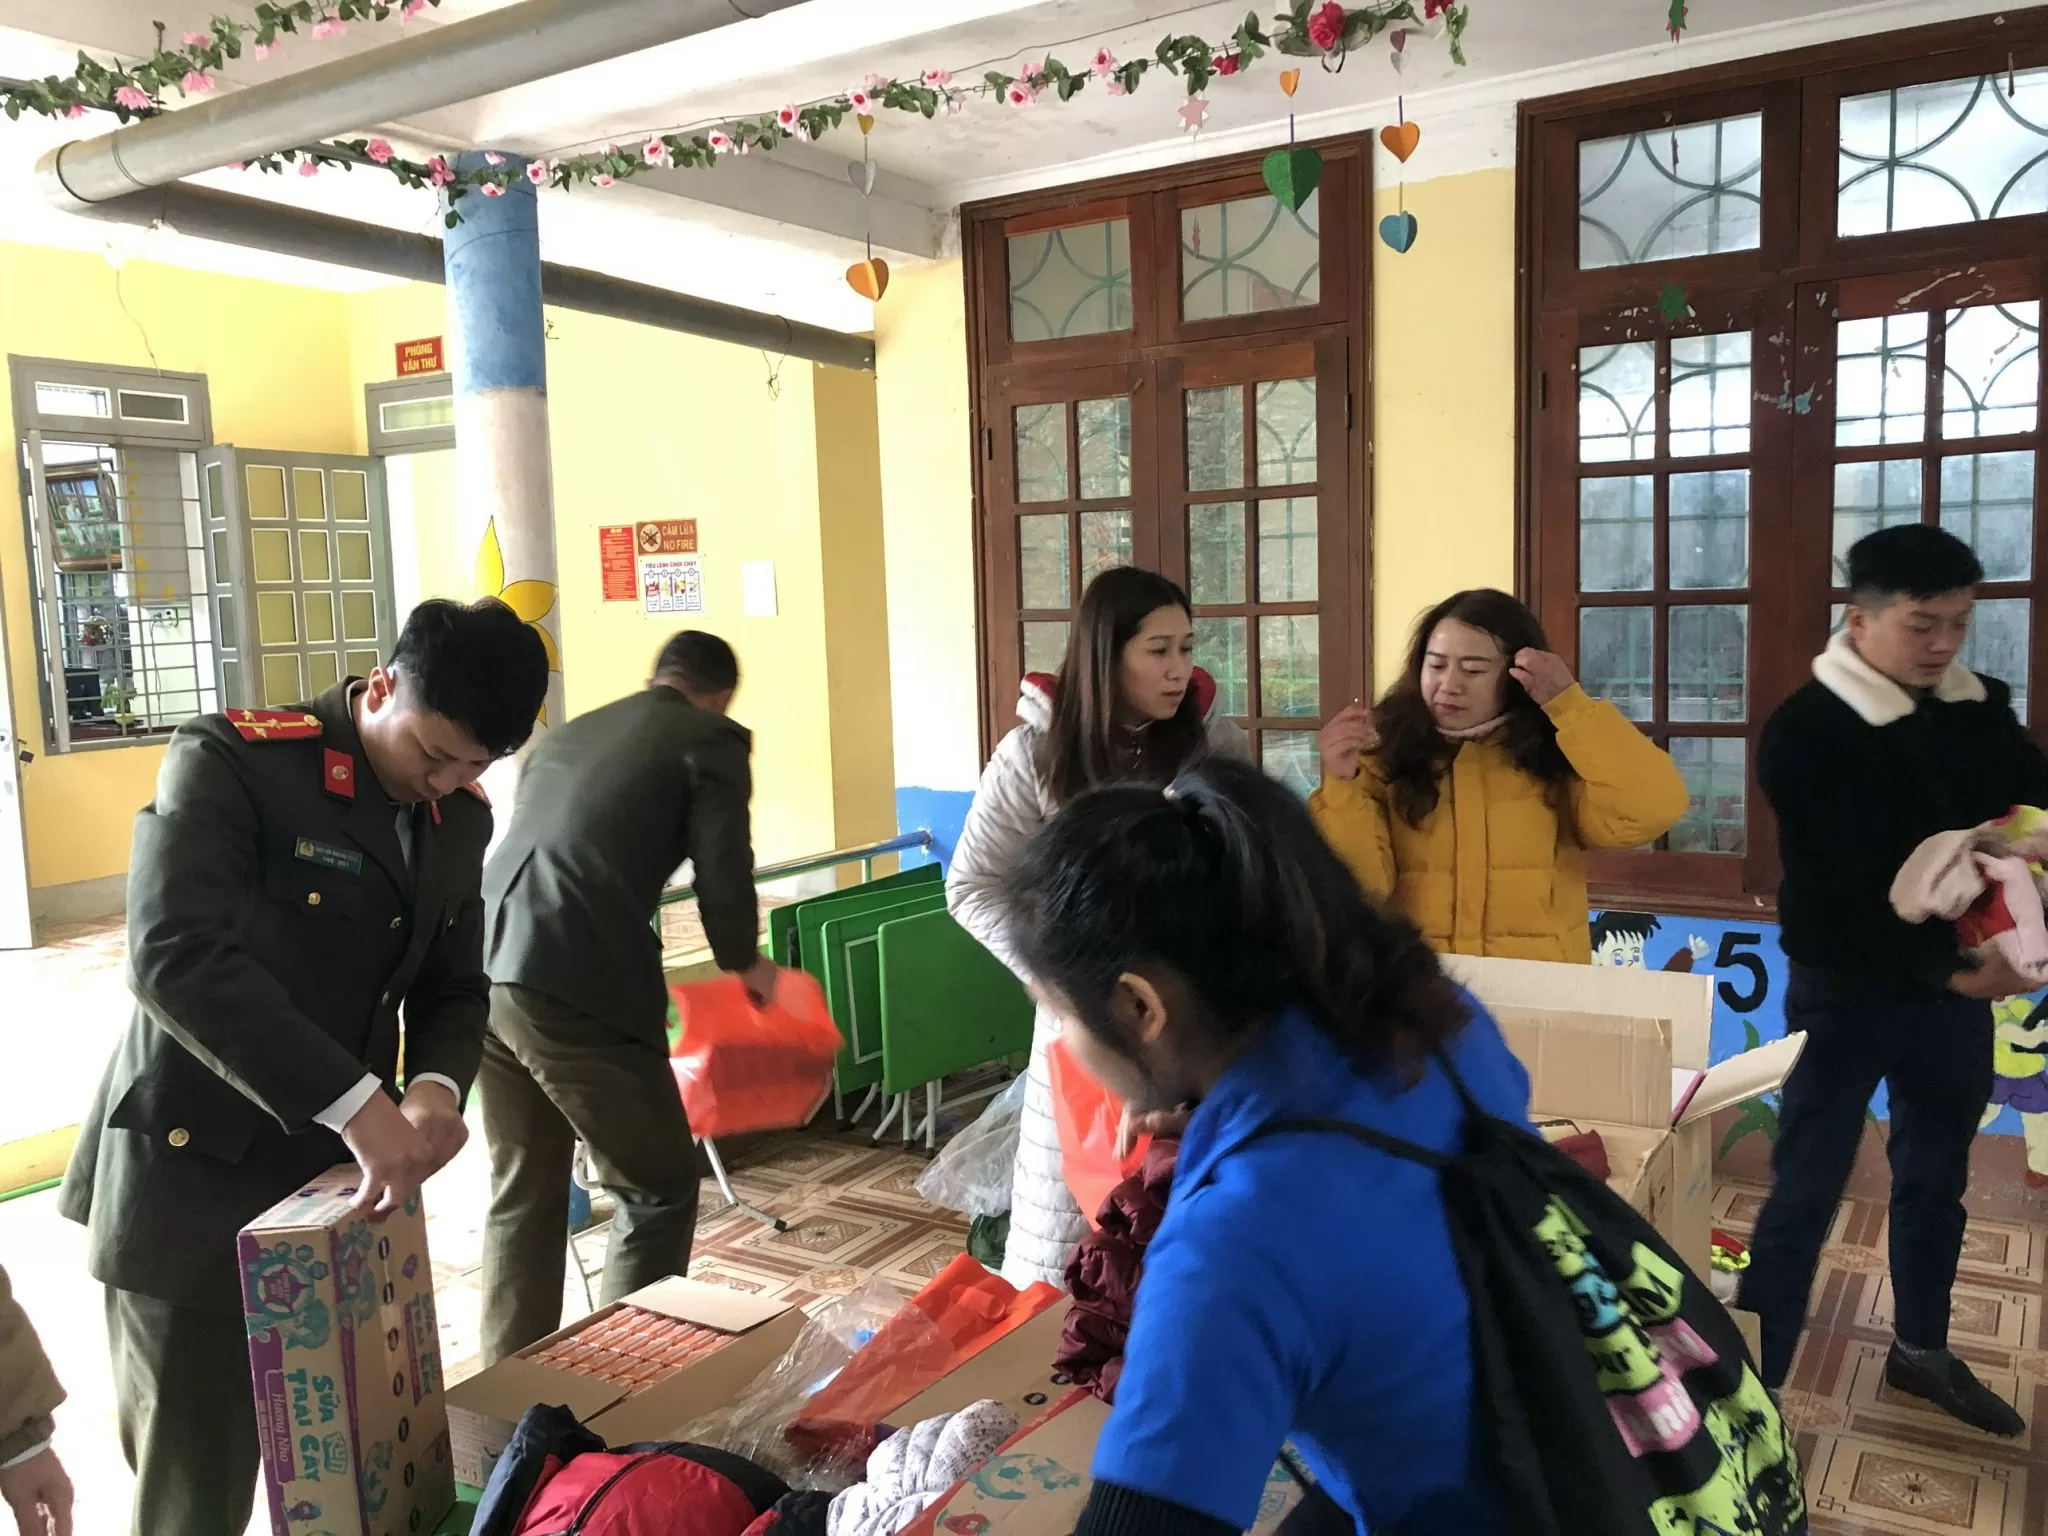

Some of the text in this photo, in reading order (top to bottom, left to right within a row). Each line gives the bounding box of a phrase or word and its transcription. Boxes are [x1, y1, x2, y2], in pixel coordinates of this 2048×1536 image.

[663, 538, 695, 551] NO FIRE
[1715, 931, 1769, 1013] 5
